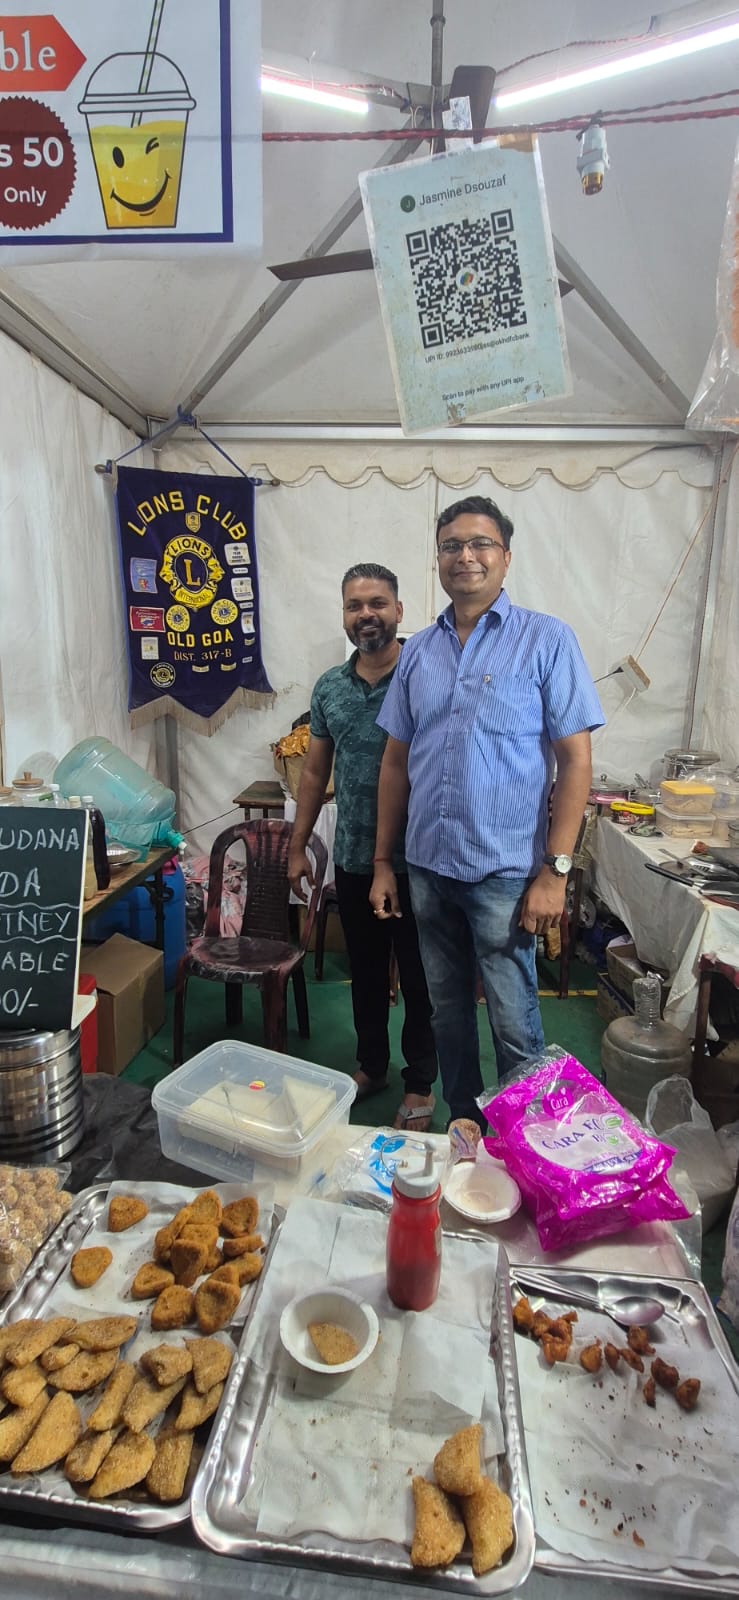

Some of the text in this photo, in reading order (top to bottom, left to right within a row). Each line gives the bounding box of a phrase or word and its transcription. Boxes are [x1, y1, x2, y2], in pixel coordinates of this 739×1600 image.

[23, 136, 64, 167] 50
[4, 186, 47, 207] Only
[419, 188, 462, 206] Jasmine
[465, 388, 475, 396] pay
[477, 383, 490, 392] with
[512, 376, 525, 384] app
[196, 494, 247, 540] CLUB
[170, 538, 209, 556] LIONS
[184, 558, 201, 586] L
[167, 631, 196, 648] OLD
[202, 628, 234, 647] GOA
[174, 648, 232, 662] DIST. 317-B
[1, 910, 71, 936] TNEY
[1, 951, 70, 974] ABLE
[550, 1096, 569, 1111] Cara
[542, 1131, 585, 1150] CARA
